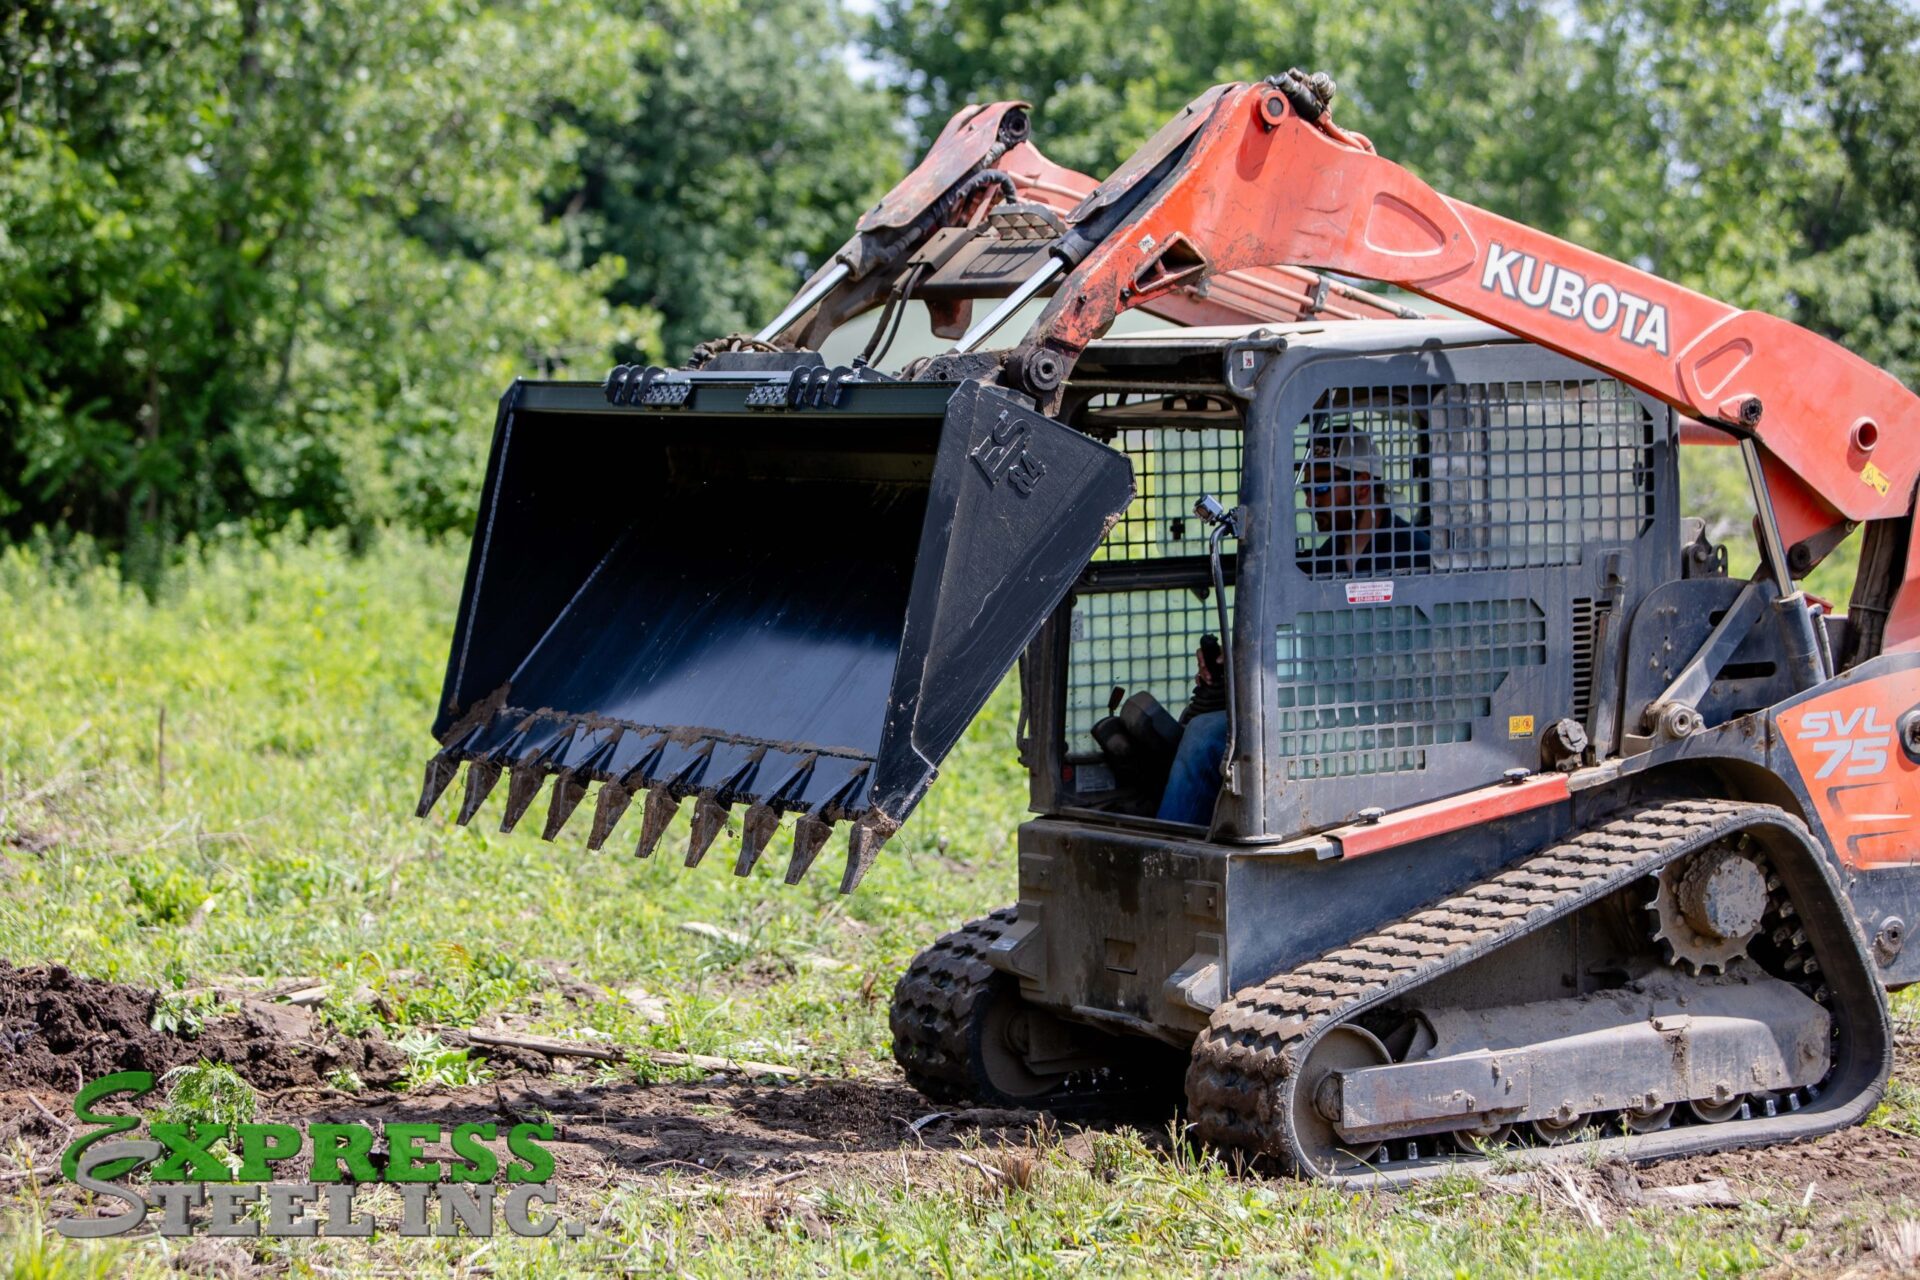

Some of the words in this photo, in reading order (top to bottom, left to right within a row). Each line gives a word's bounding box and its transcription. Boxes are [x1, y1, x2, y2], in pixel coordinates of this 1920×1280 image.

[1481, 241, 1669, 355] KUBOTA
[1007, 450, 1046, 497] 84
[1797, 706, 1892, 740] SVL
[1812, 736, 1890, 780] 75
